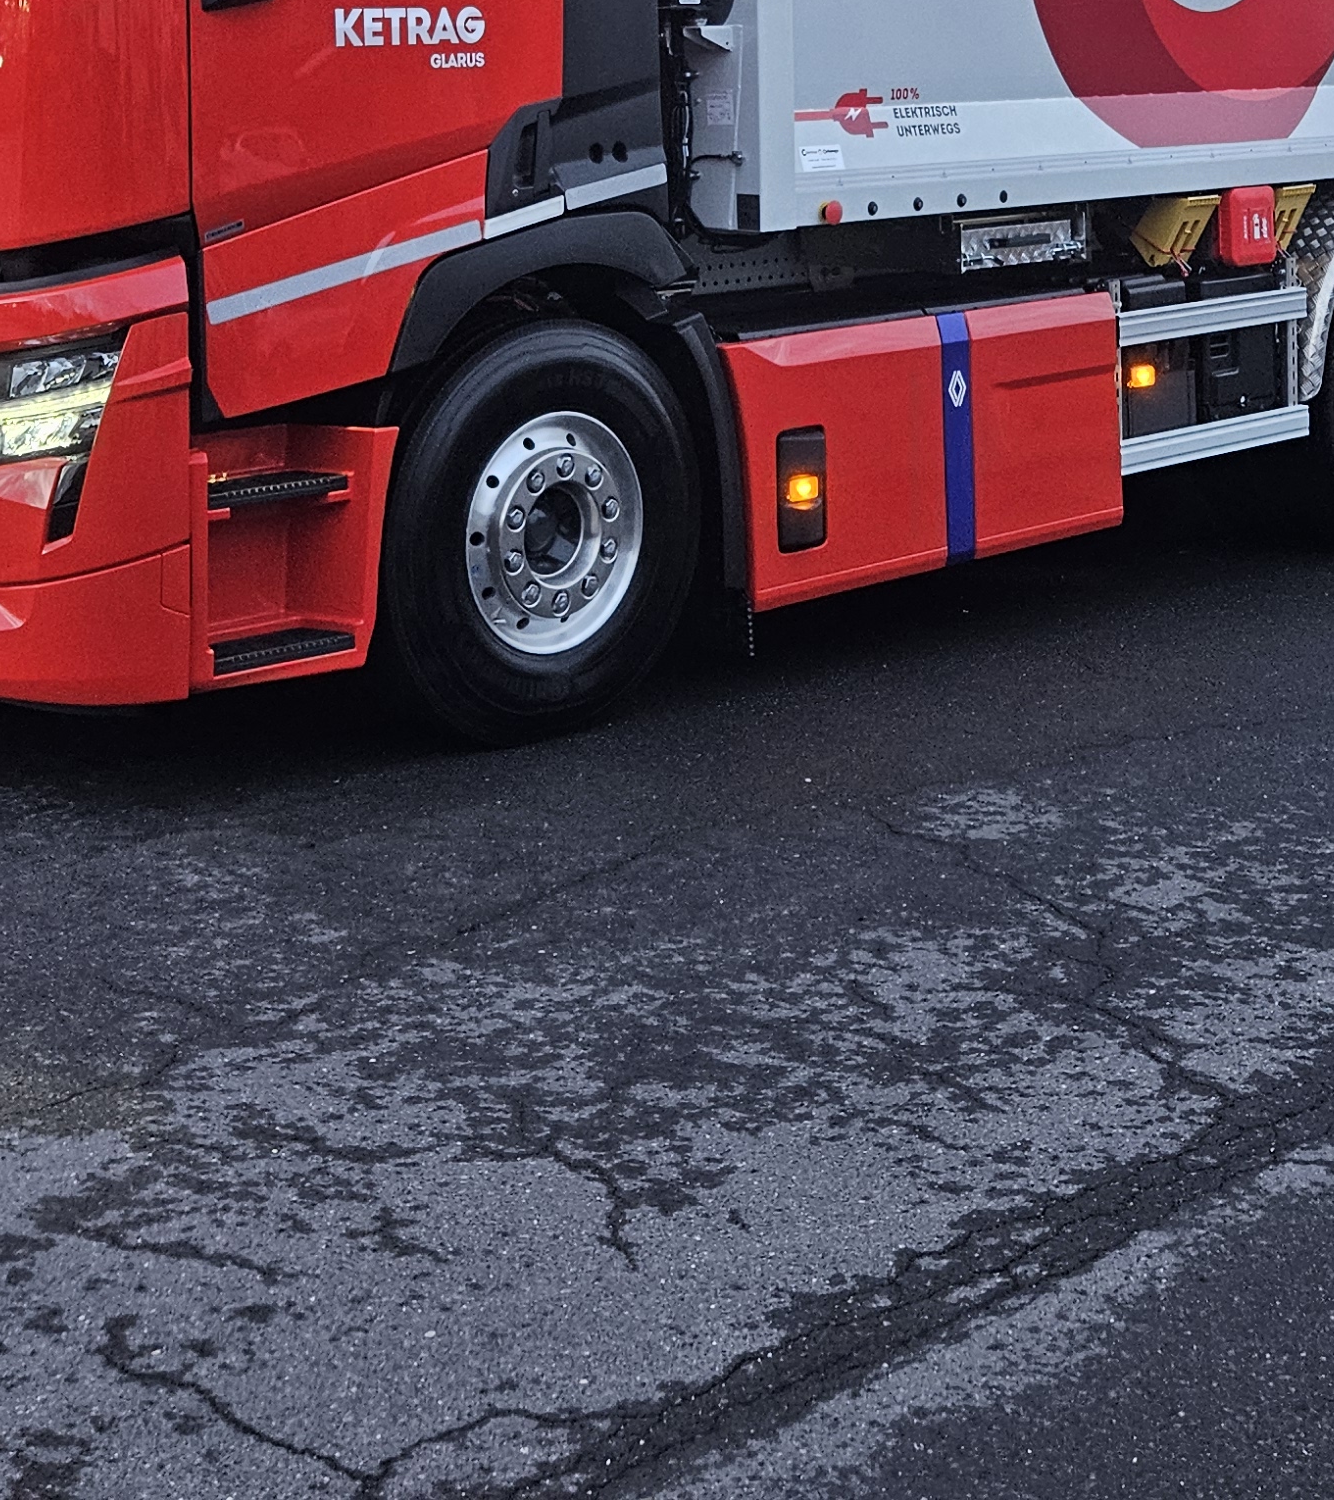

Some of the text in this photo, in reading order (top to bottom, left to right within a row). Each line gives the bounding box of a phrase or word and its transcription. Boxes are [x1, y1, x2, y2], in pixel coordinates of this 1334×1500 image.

[334, 6, 486, 47] KETRAG
[430, 52, 485, 69] GLARUS
[890, 87, 920, 100] 100%
[893, 105, 958, 119] ELEKTRISCH
[896, 123, 961, 137] UNTERWEGS
